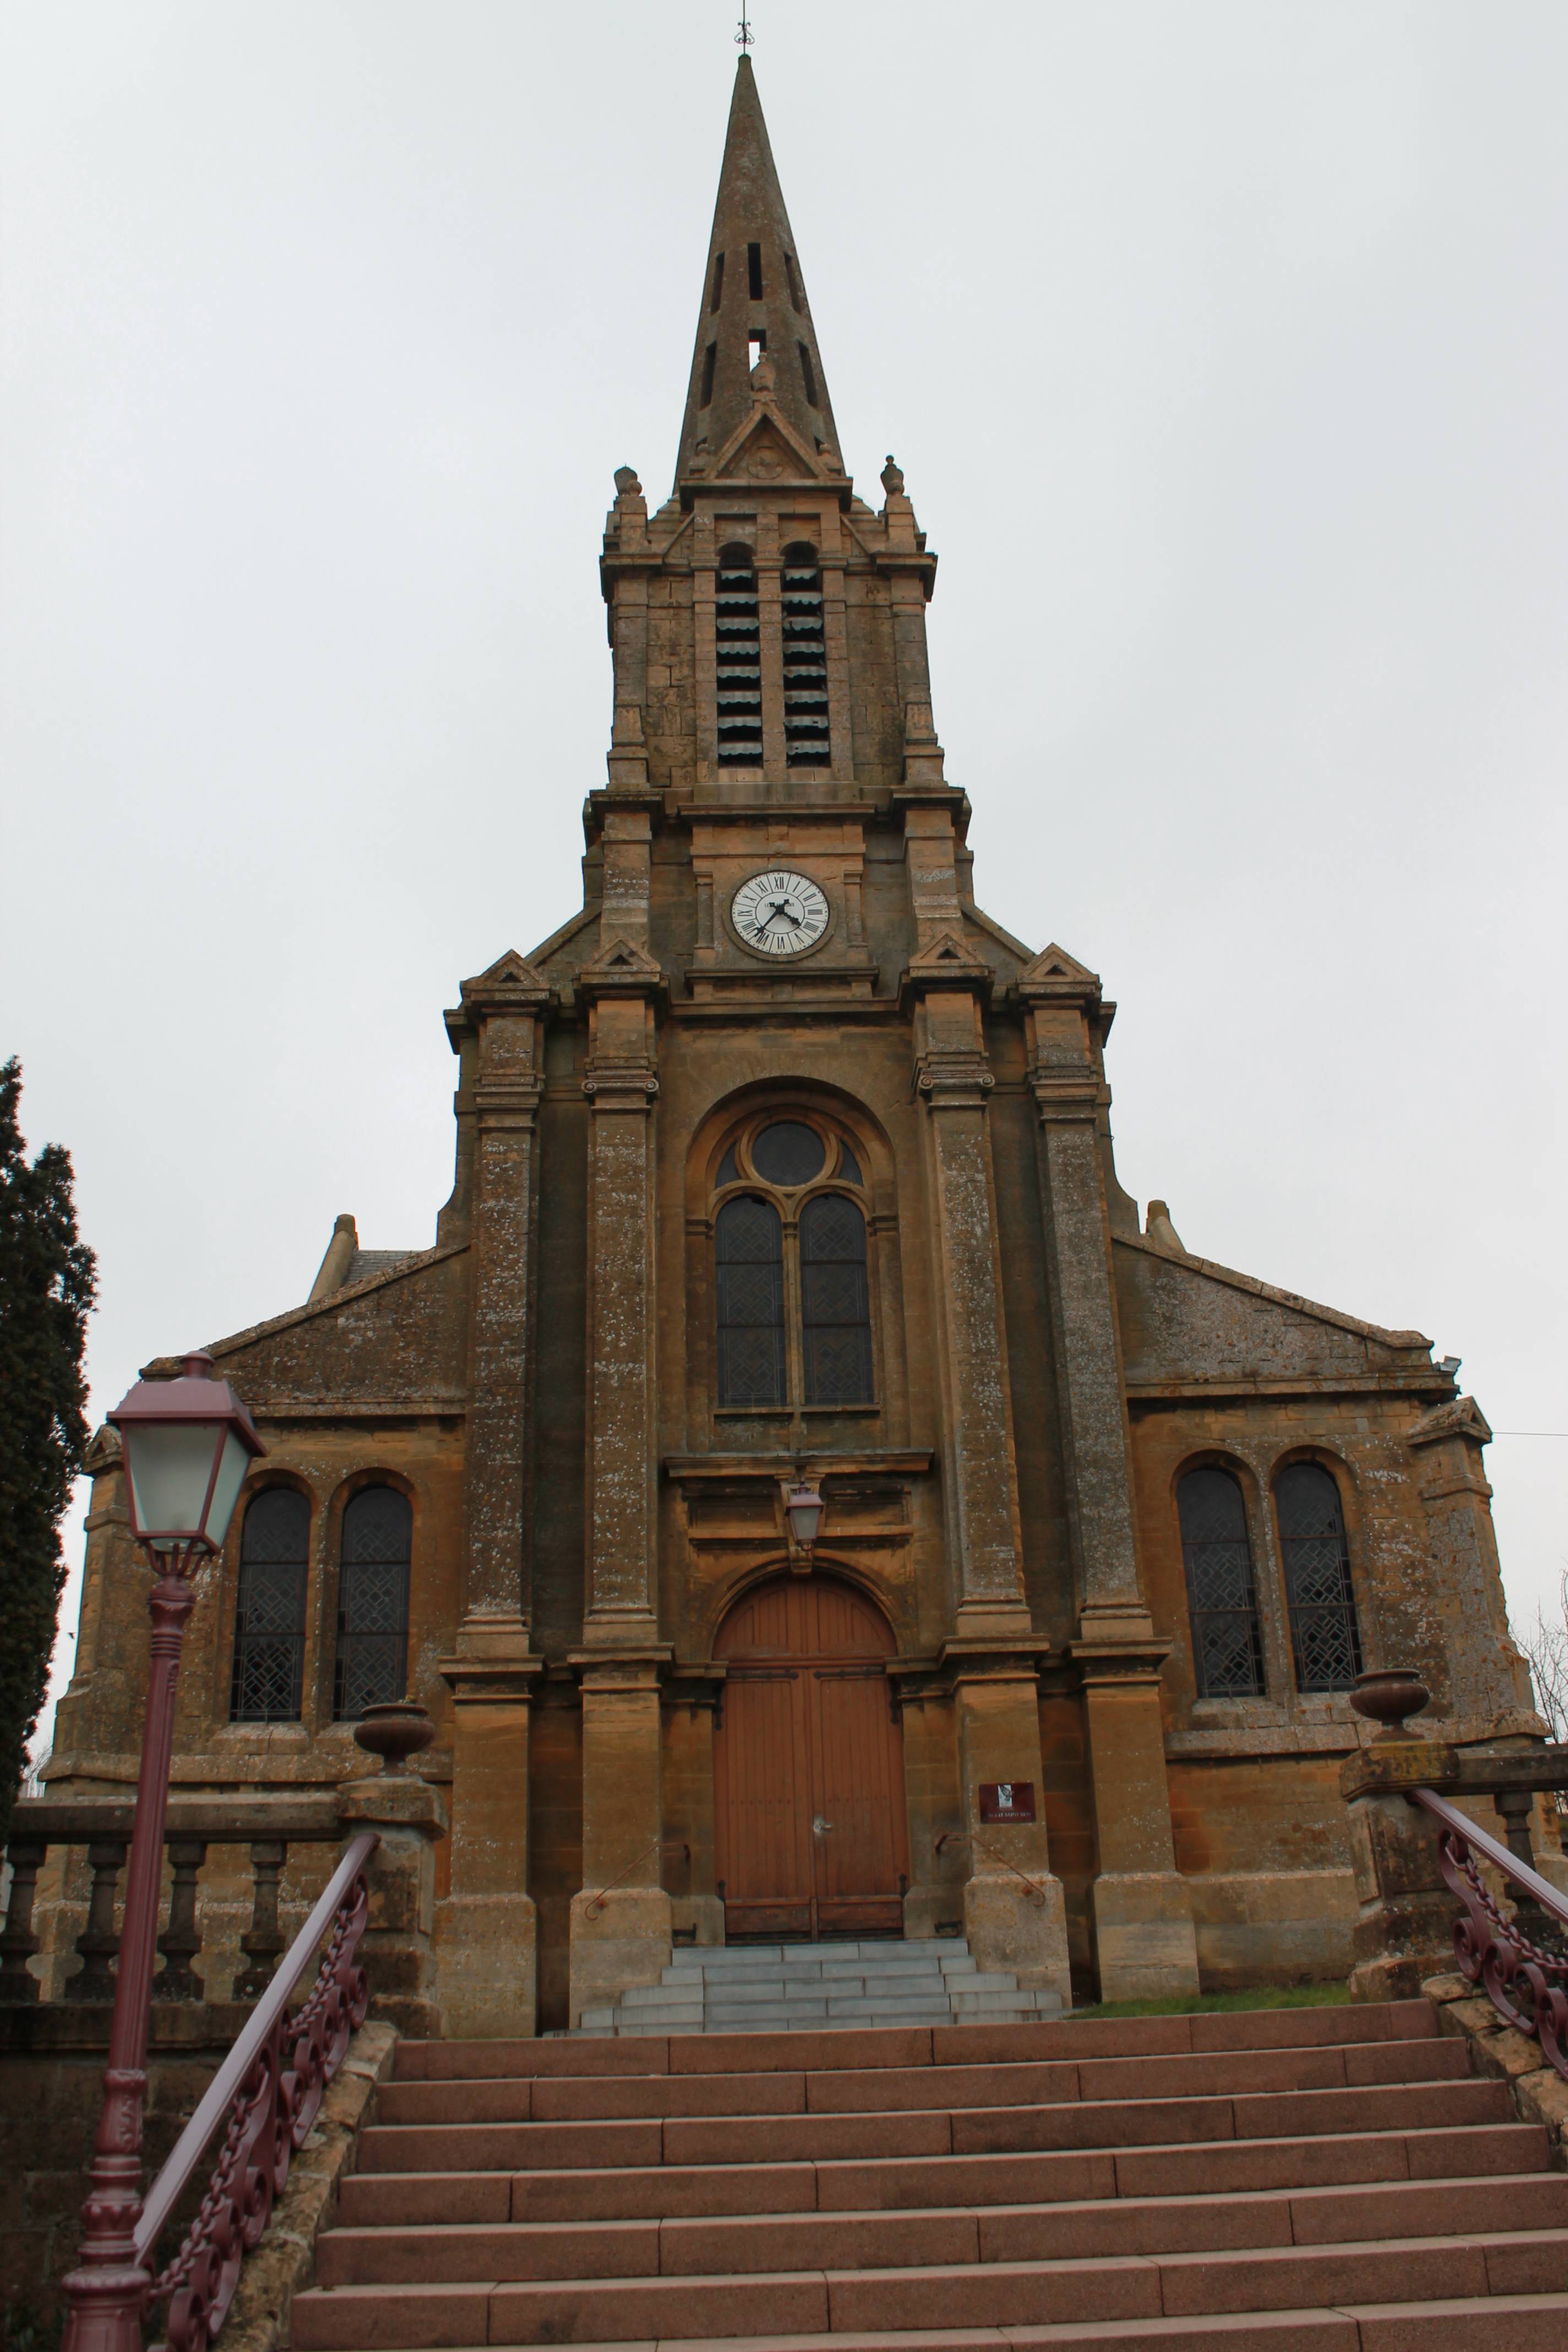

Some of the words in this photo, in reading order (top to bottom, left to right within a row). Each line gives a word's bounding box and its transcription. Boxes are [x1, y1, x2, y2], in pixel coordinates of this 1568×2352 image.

[755, 880, 768, 894] XI
[774, 876, 784, 889] XII
[793, 881, 801, 892] I
[742, 894, 756, 903] X
[803, 893, 817, 902] II
[777, 936, 785, 950] VI
[794, 933, 804, 945] V
